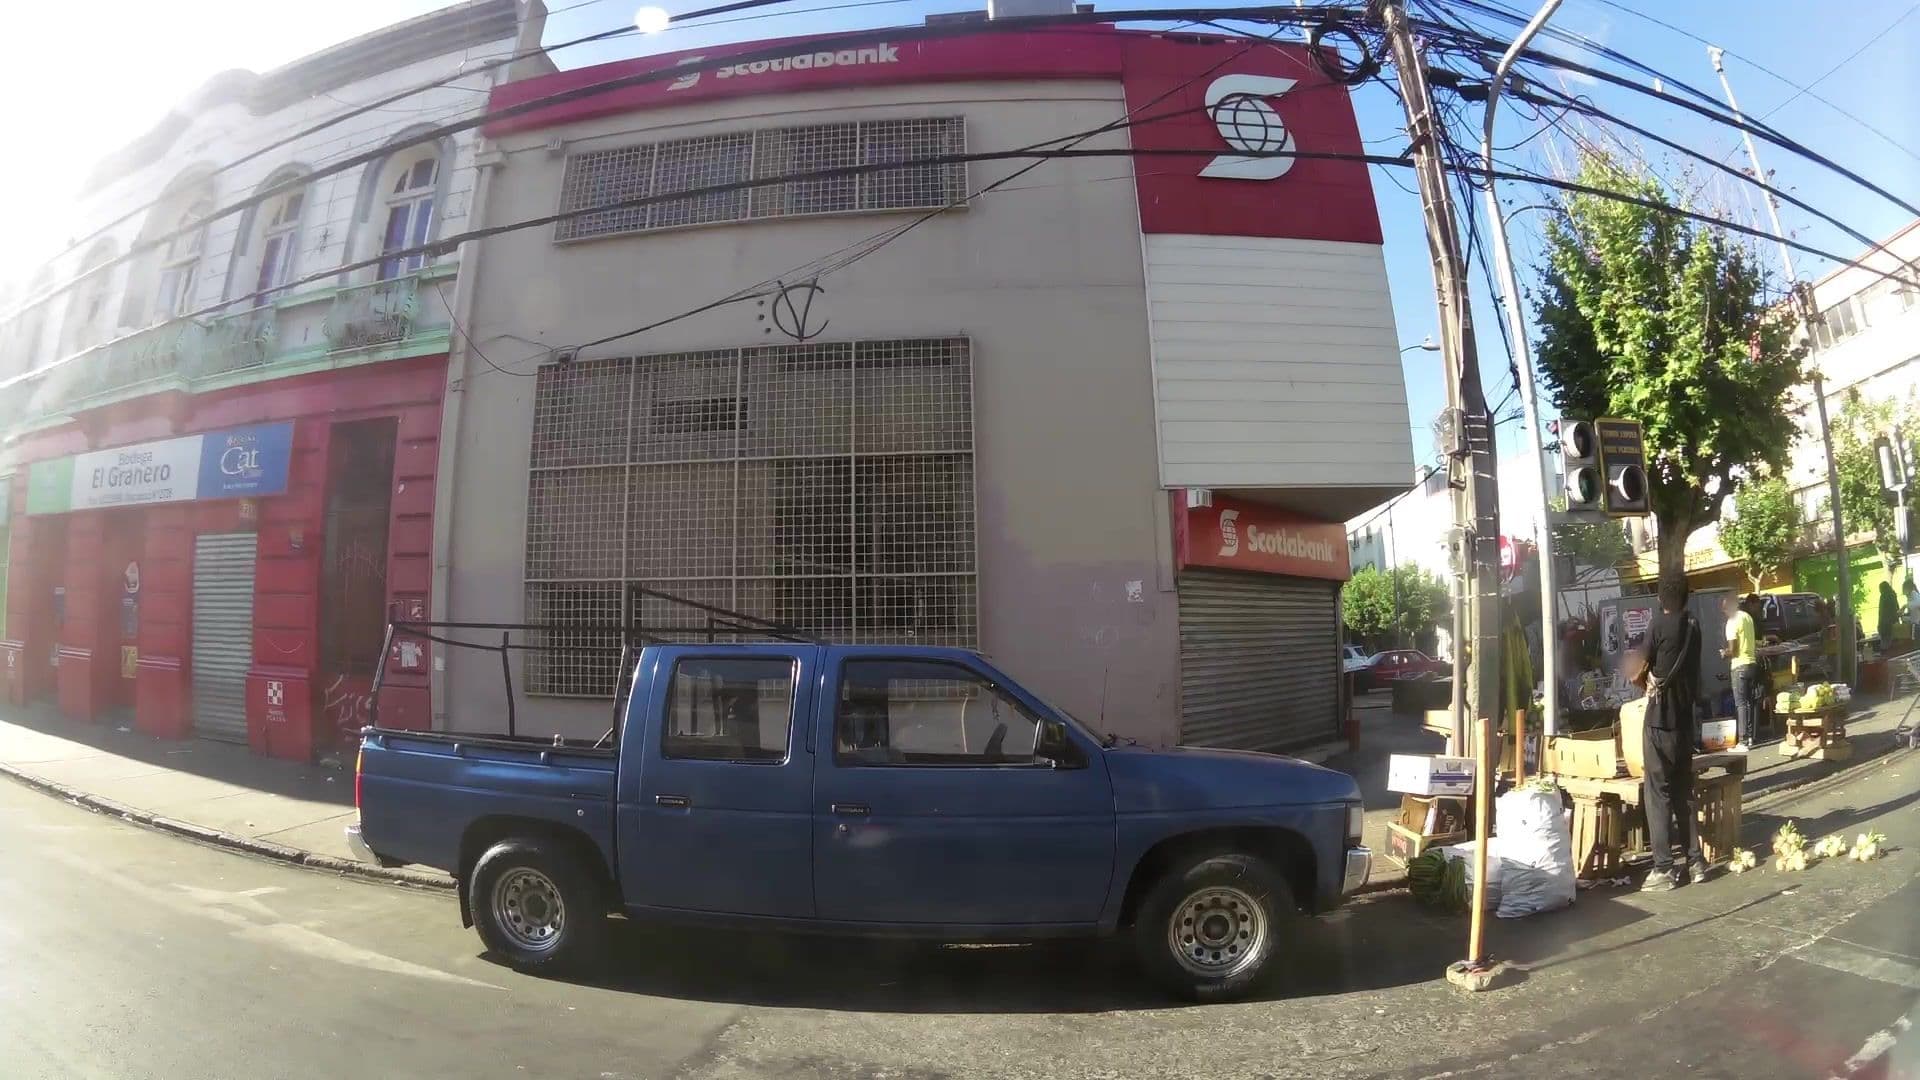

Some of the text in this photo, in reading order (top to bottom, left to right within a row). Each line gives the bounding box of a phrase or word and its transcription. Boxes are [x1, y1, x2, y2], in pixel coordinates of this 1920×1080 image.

[220, 446, 260, 475] Cat
[92, 463, 171, 489] El Granero
[1246, 524, 1334, 563] Scotiabank
